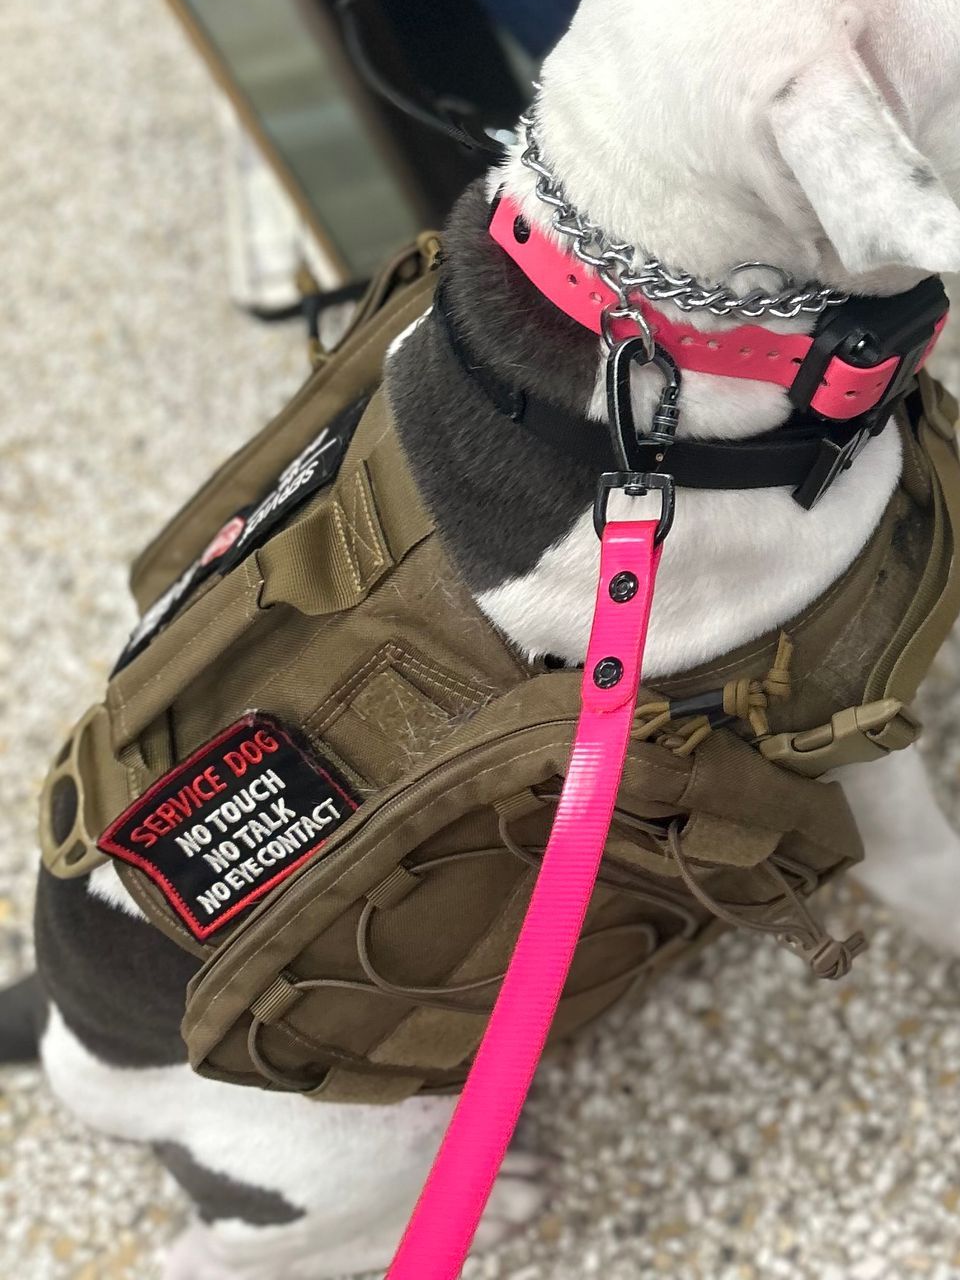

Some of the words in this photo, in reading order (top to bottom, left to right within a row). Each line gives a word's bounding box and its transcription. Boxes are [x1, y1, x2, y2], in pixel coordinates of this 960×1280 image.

[130, 765, 228, 848] SERVICE
[223, 729, 279, 778] DOG
[174, 829, 213, 858] NO
[204, 768, 286, 833] TOUCH
[202, 840, 241, 874] NO
[232, 797, 296, 849] TALK
[196, 881, 231, 915] NO
[227, 857, 264, 891] EYE
[257, 797, 341, 867] CONTACT
